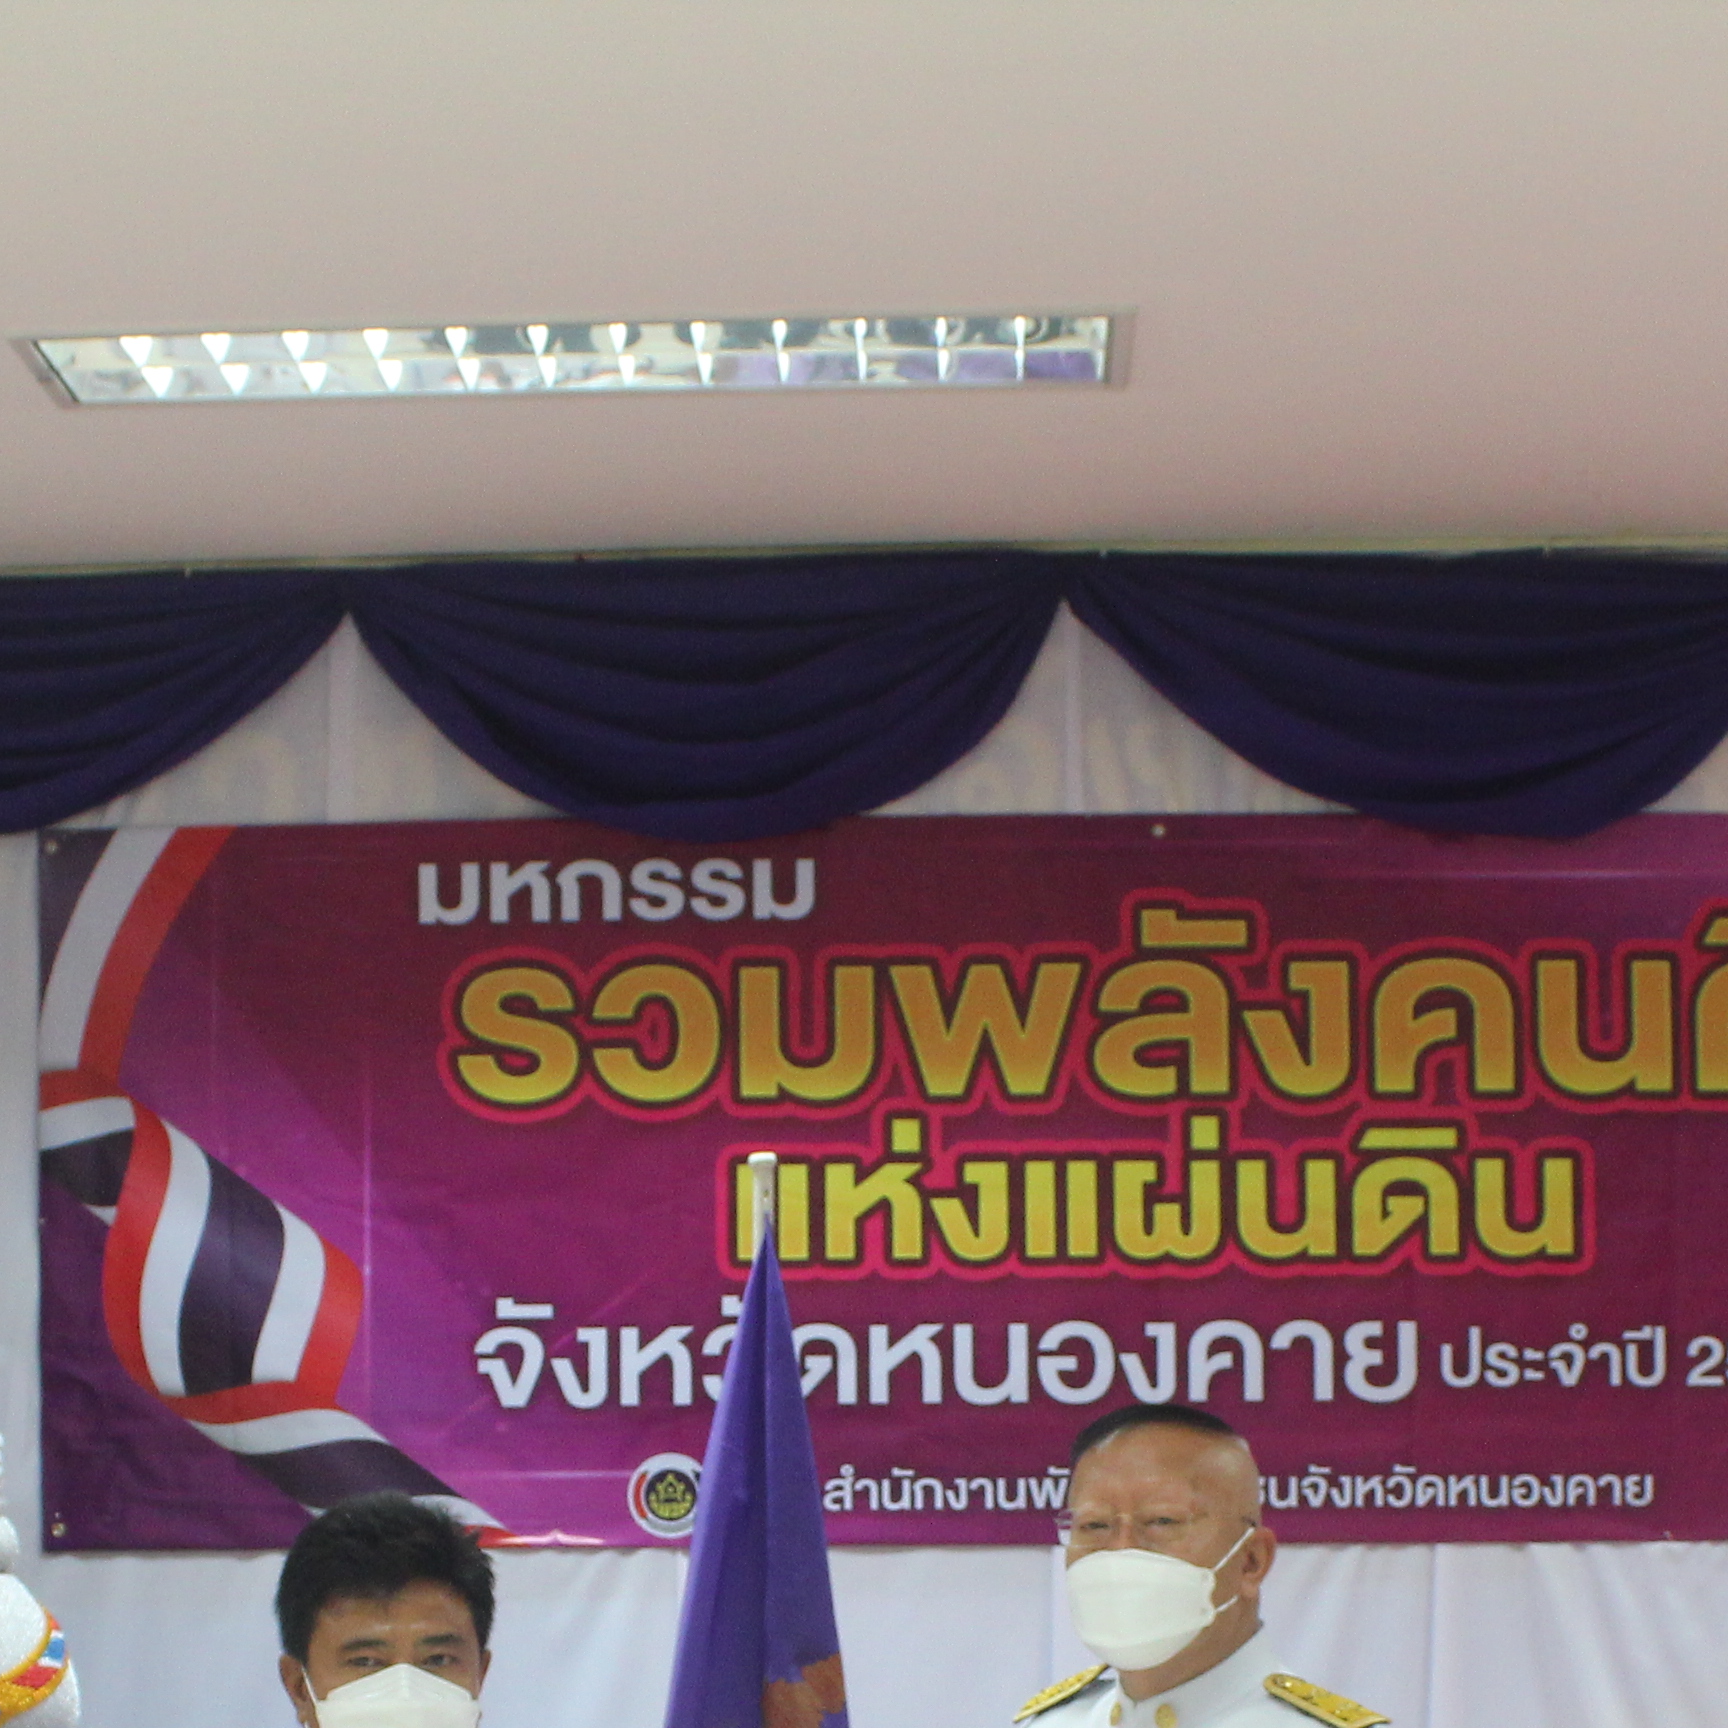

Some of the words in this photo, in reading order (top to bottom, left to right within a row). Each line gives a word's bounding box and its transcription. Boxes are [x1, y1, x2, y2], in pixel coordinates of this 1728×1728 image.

[417, 856, 817, 926] มหกรรม
[735, 1114, 1576, 1262] แห่งแผ่นดิน
[1439, 1322, 1668, 1389] ประจำปี
